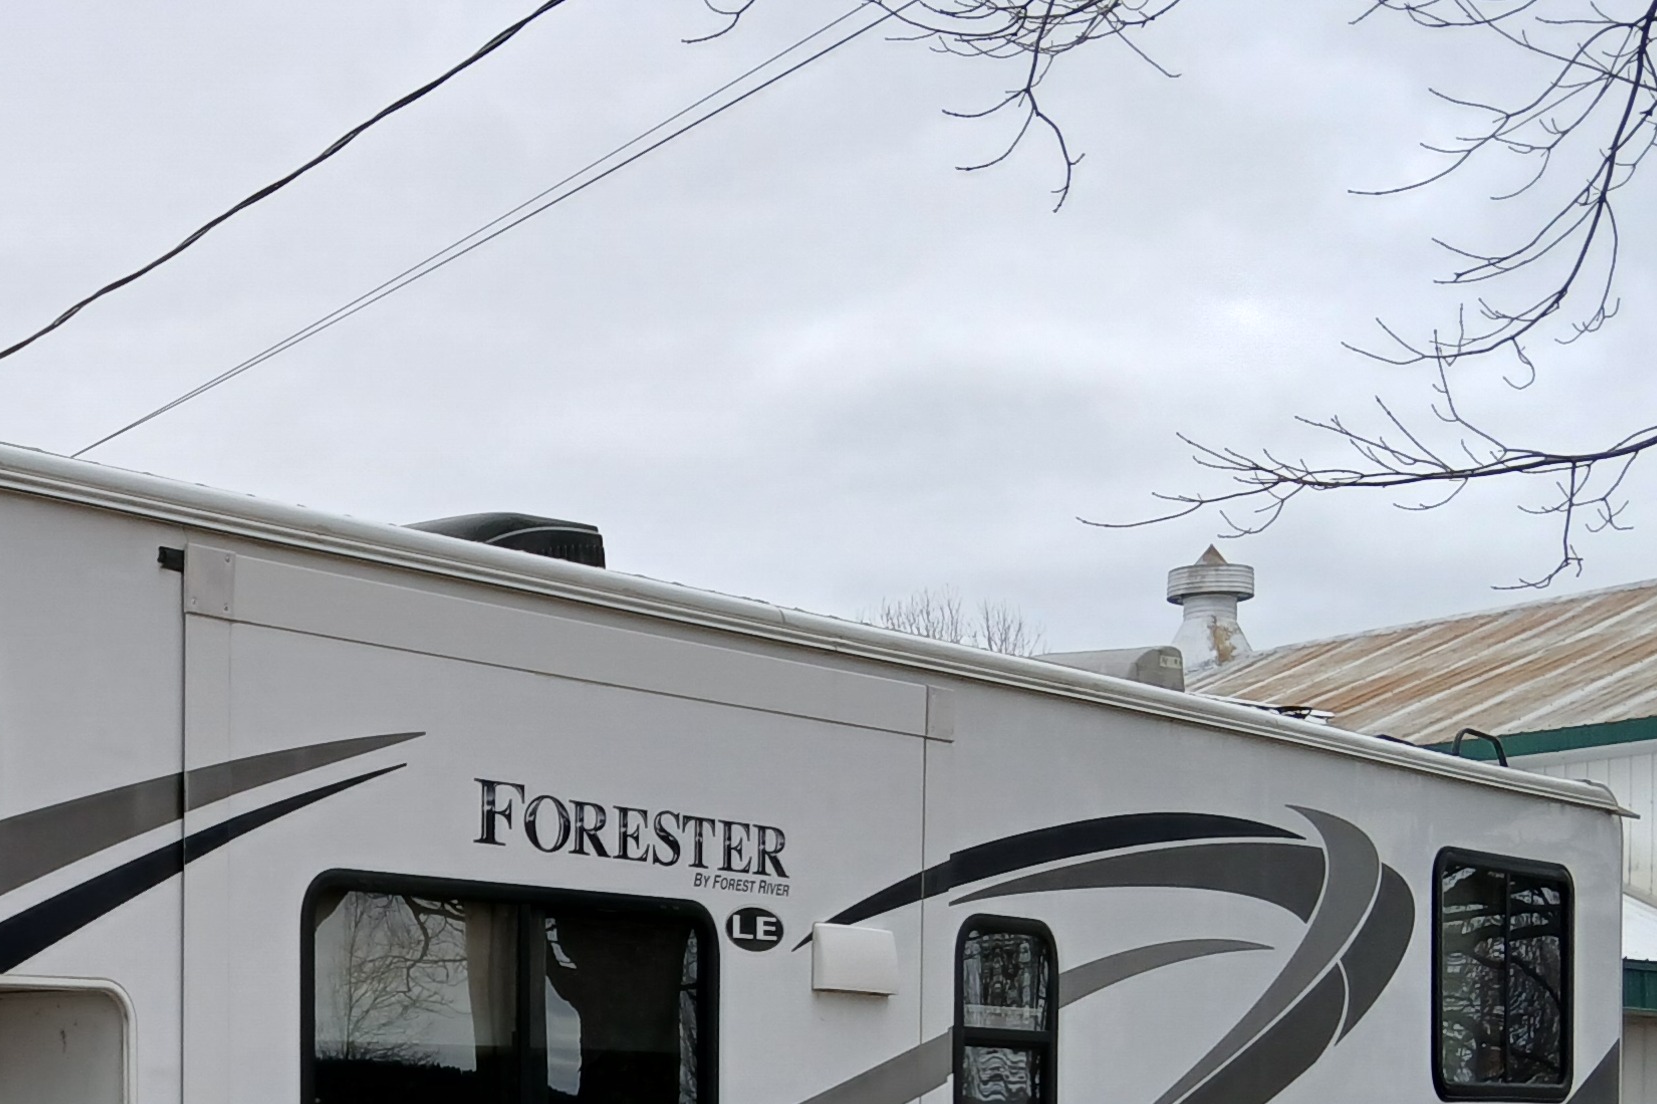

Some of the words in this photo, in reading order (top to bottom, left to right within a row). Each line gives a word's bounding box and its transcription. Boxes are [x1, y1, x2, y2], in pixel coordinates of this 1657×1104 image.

[472, 777, 791, 879] FORESTER
[693, 872, 710, 888] BY
[712, 874, 756, 894] FOREST
[758, 879, 790, 897] RIVER
[732, 914, 778, 941] LE
